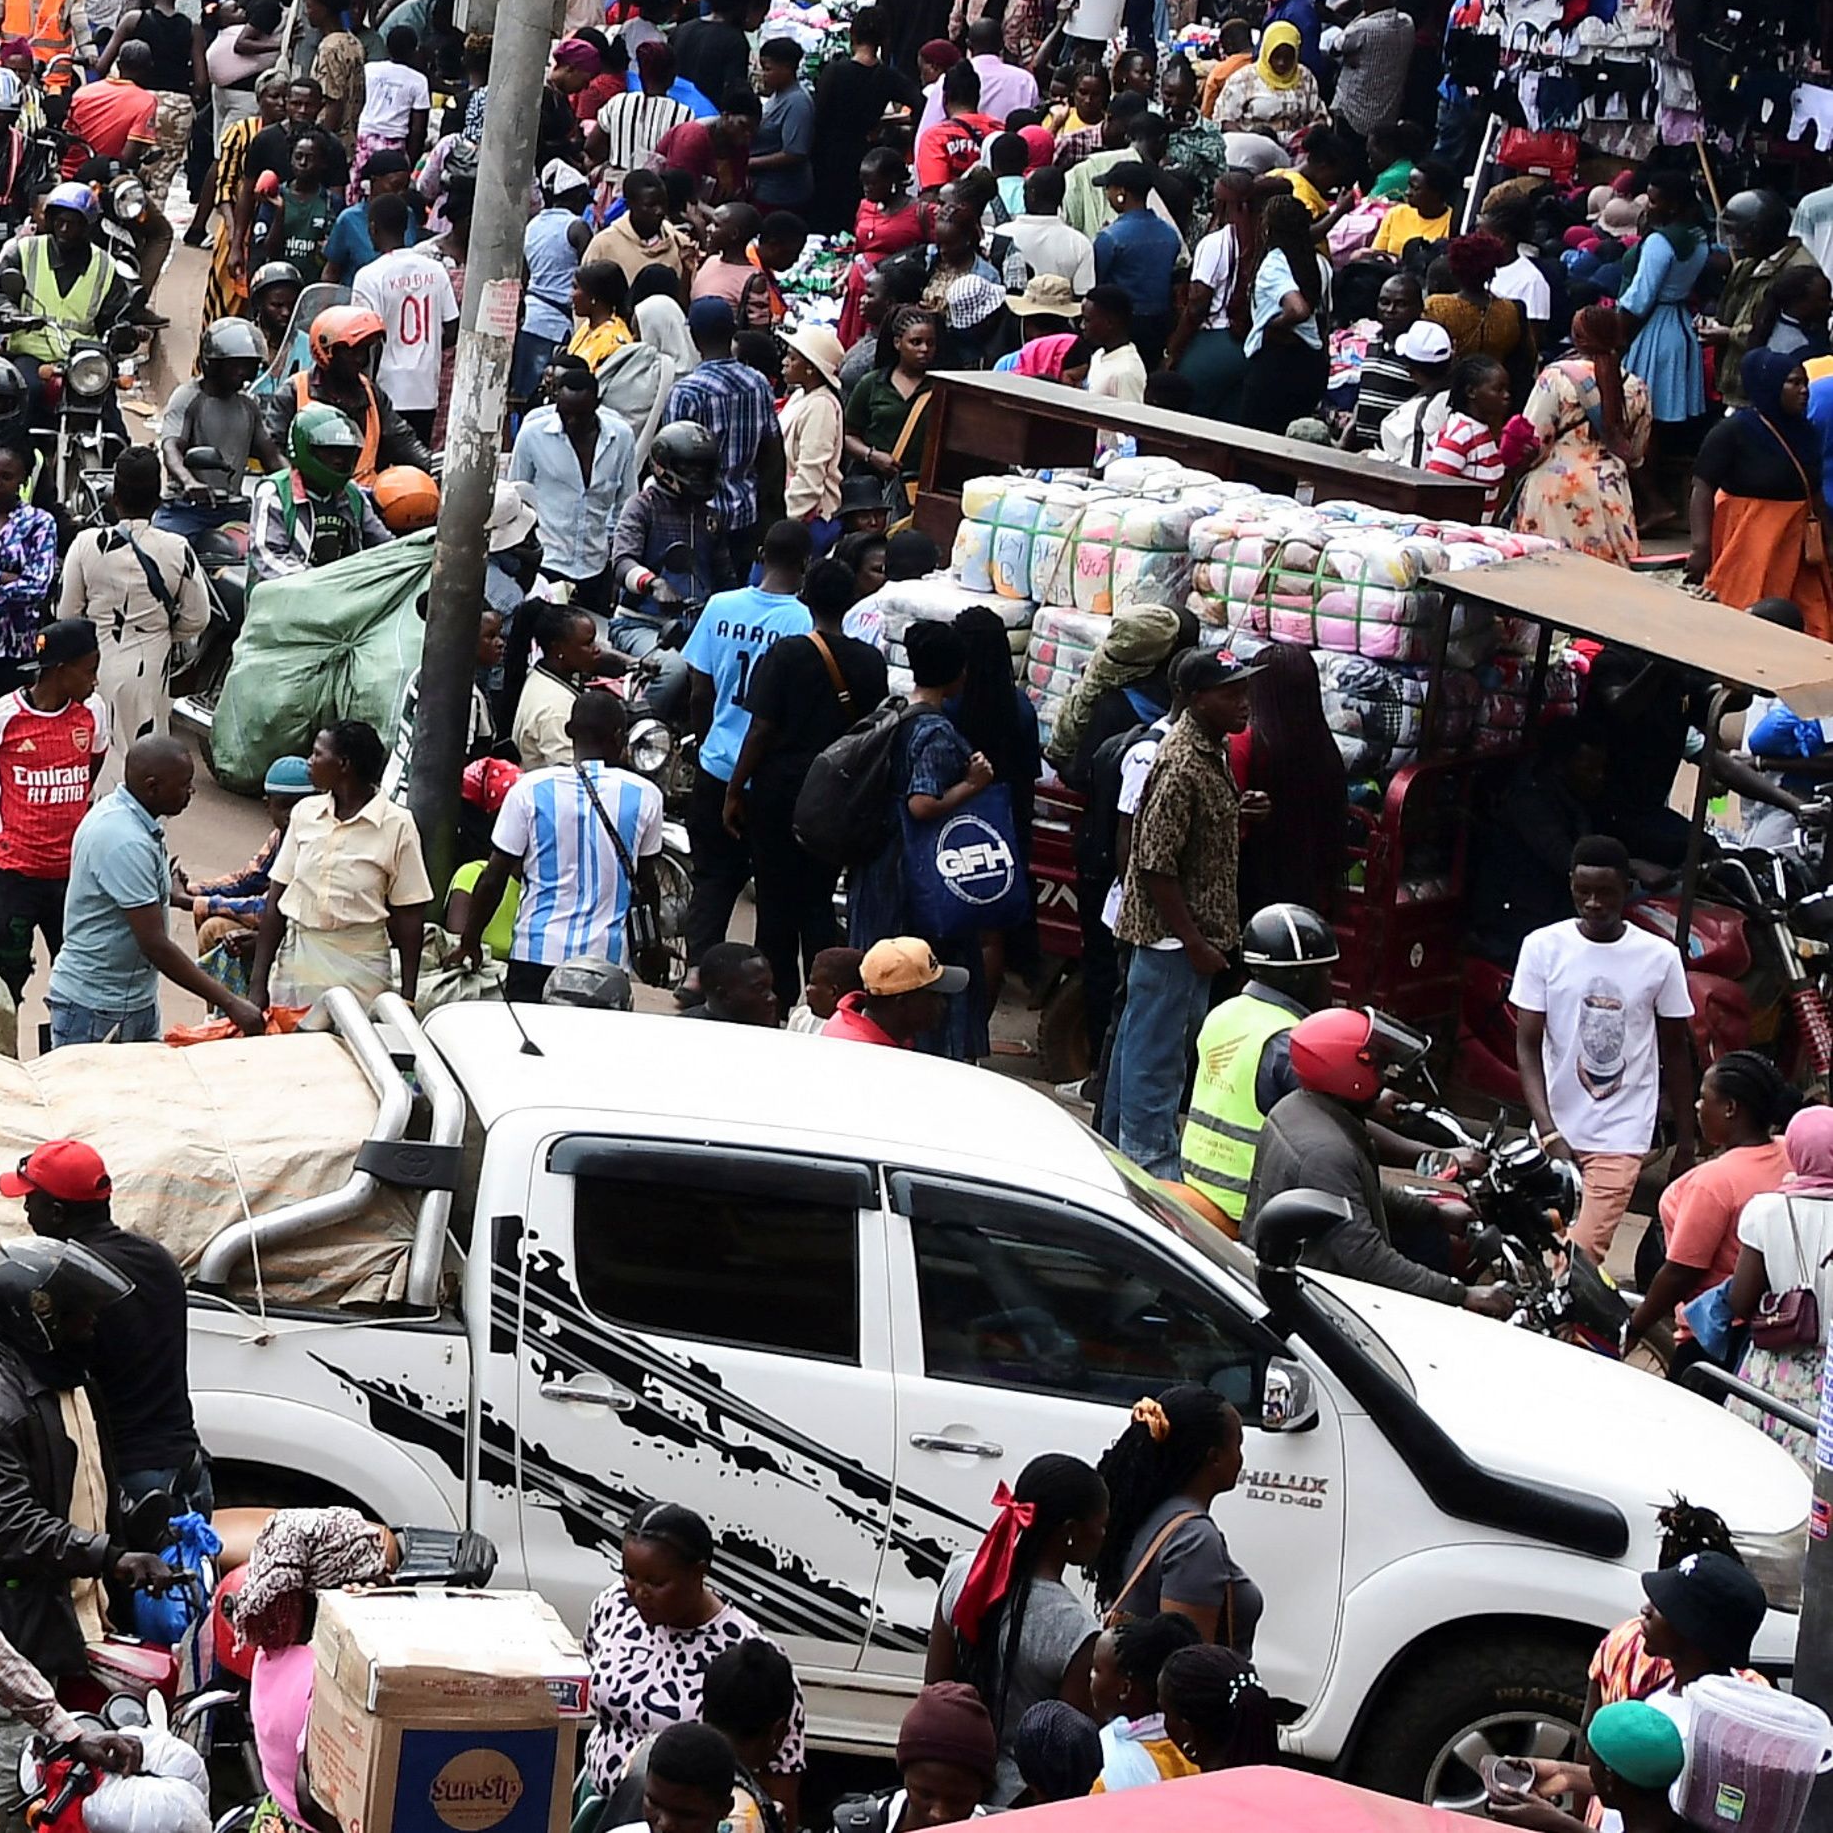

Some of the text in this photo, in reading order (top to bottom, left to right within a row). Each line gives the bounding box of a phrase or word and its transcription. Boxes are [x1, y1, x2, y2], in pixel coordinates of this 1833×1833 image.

[399, 294, 431, 346] 01
[12, 761, 90, 788] Emirates
[28, 783, 86, 804] FLY BETTER
[936, 837, 1014, 879] GFH
